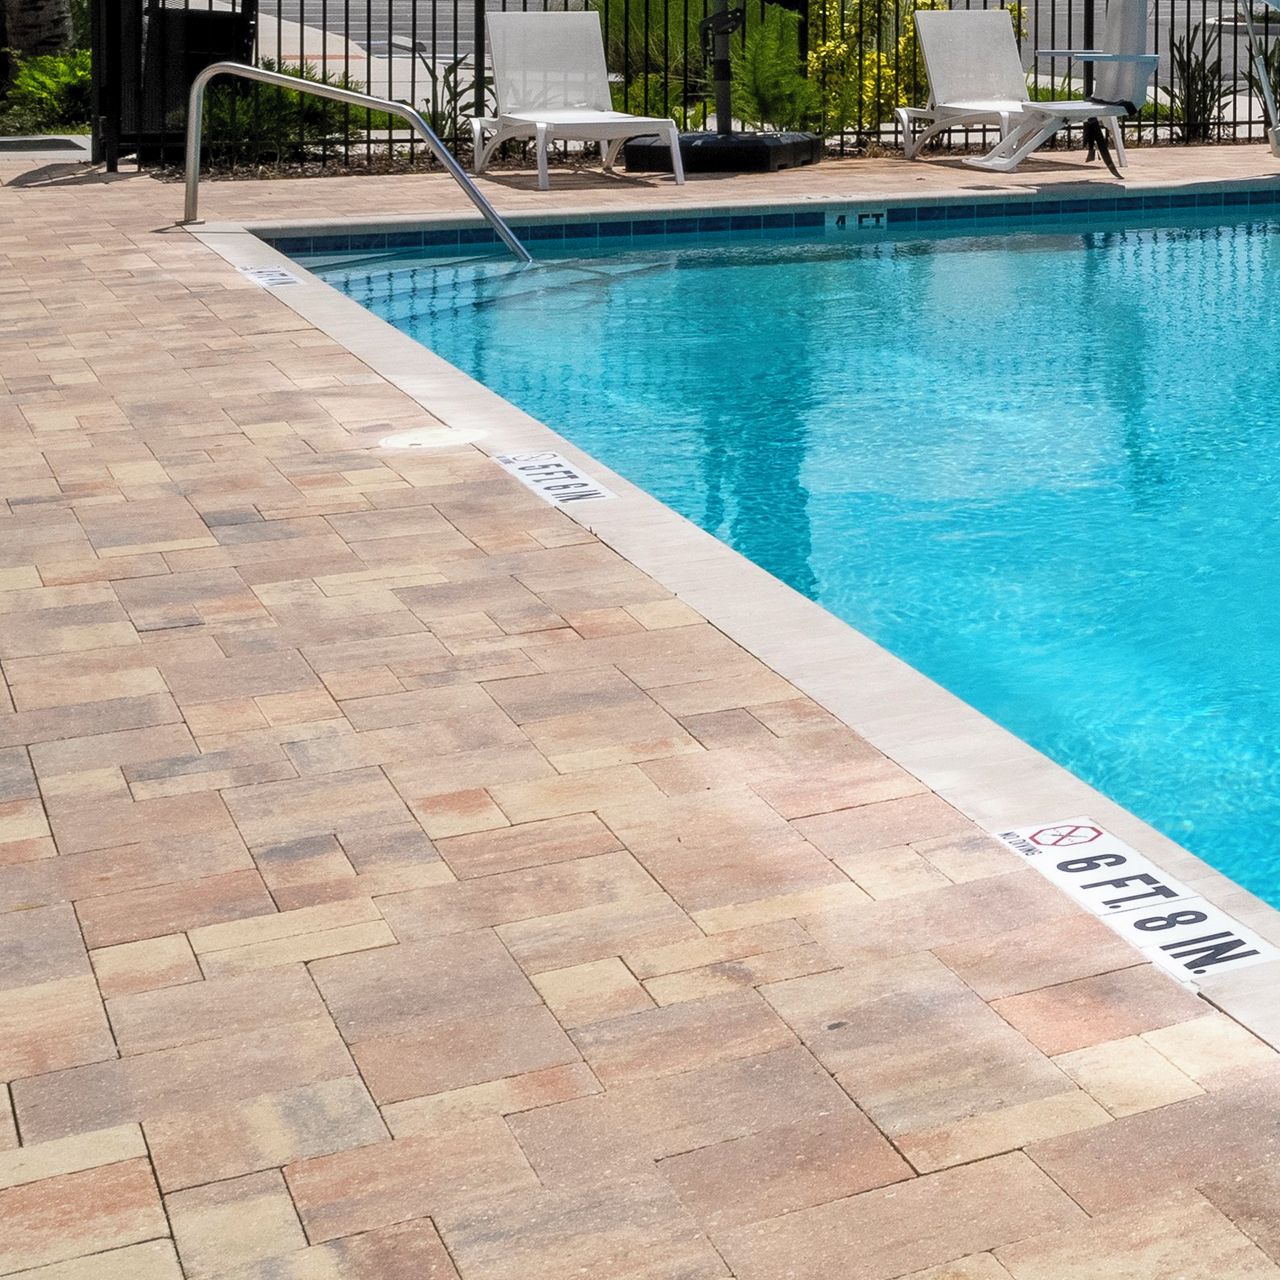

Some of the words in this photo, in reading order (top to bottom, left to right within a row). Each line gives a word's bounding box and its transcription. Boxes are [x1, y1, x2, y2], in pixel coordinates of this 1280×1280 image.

[518, 463, 564, 471] 5
[543, 482, 589, 491] 6
[1056, 853, 1127, 873] 6
[1079, 873, 1180, 909] FT.
[1133, 910, 1208, 932] 8
[1159, 931, 1261, 975] IN.
